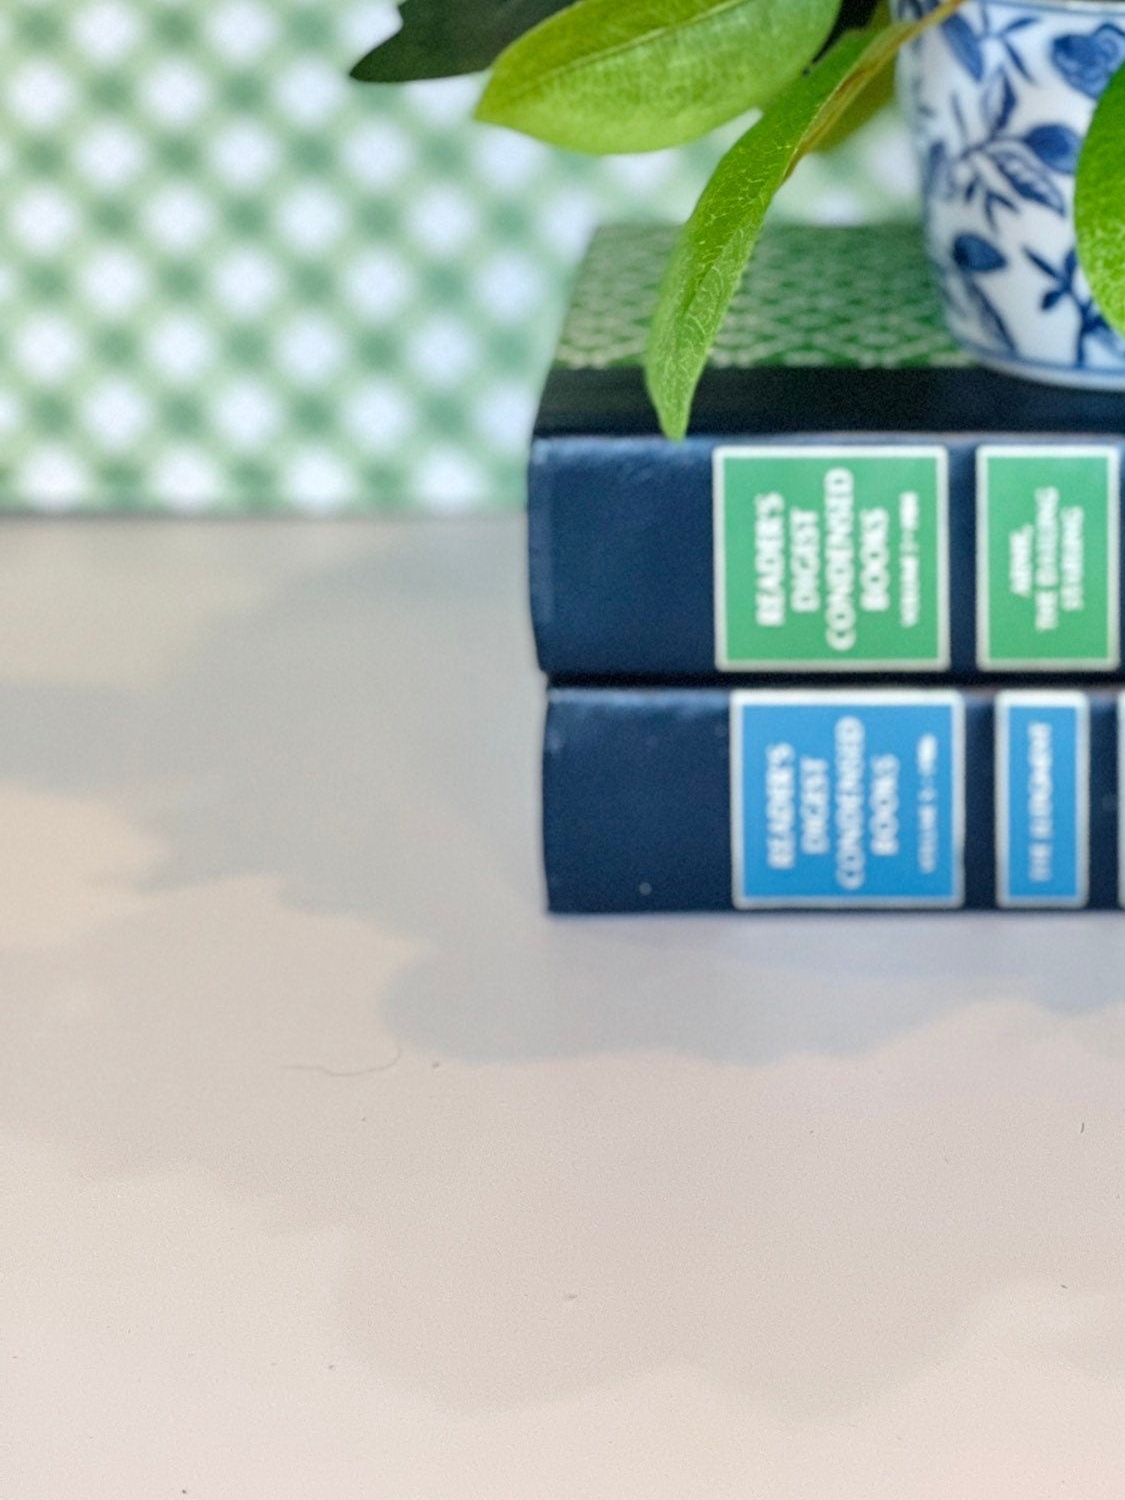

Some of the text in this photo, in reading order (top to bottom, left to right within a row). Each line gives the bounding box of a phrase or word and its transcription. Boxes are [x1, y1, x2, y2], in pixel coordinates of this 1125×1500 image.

[756, 494, 784, 625] READER'S
[791, 509, 819, 611] DIGEST
[825, 468, 854, 649] CONDENSED
[861, 508, 888, 610] BOOKS
[767, 744, 794, 867] READER'S
[801, 758, 828, 853] DIGEST
[836, 716, 864, 887] CONDENSED
[870, 755, 898, 854] BOOKS
